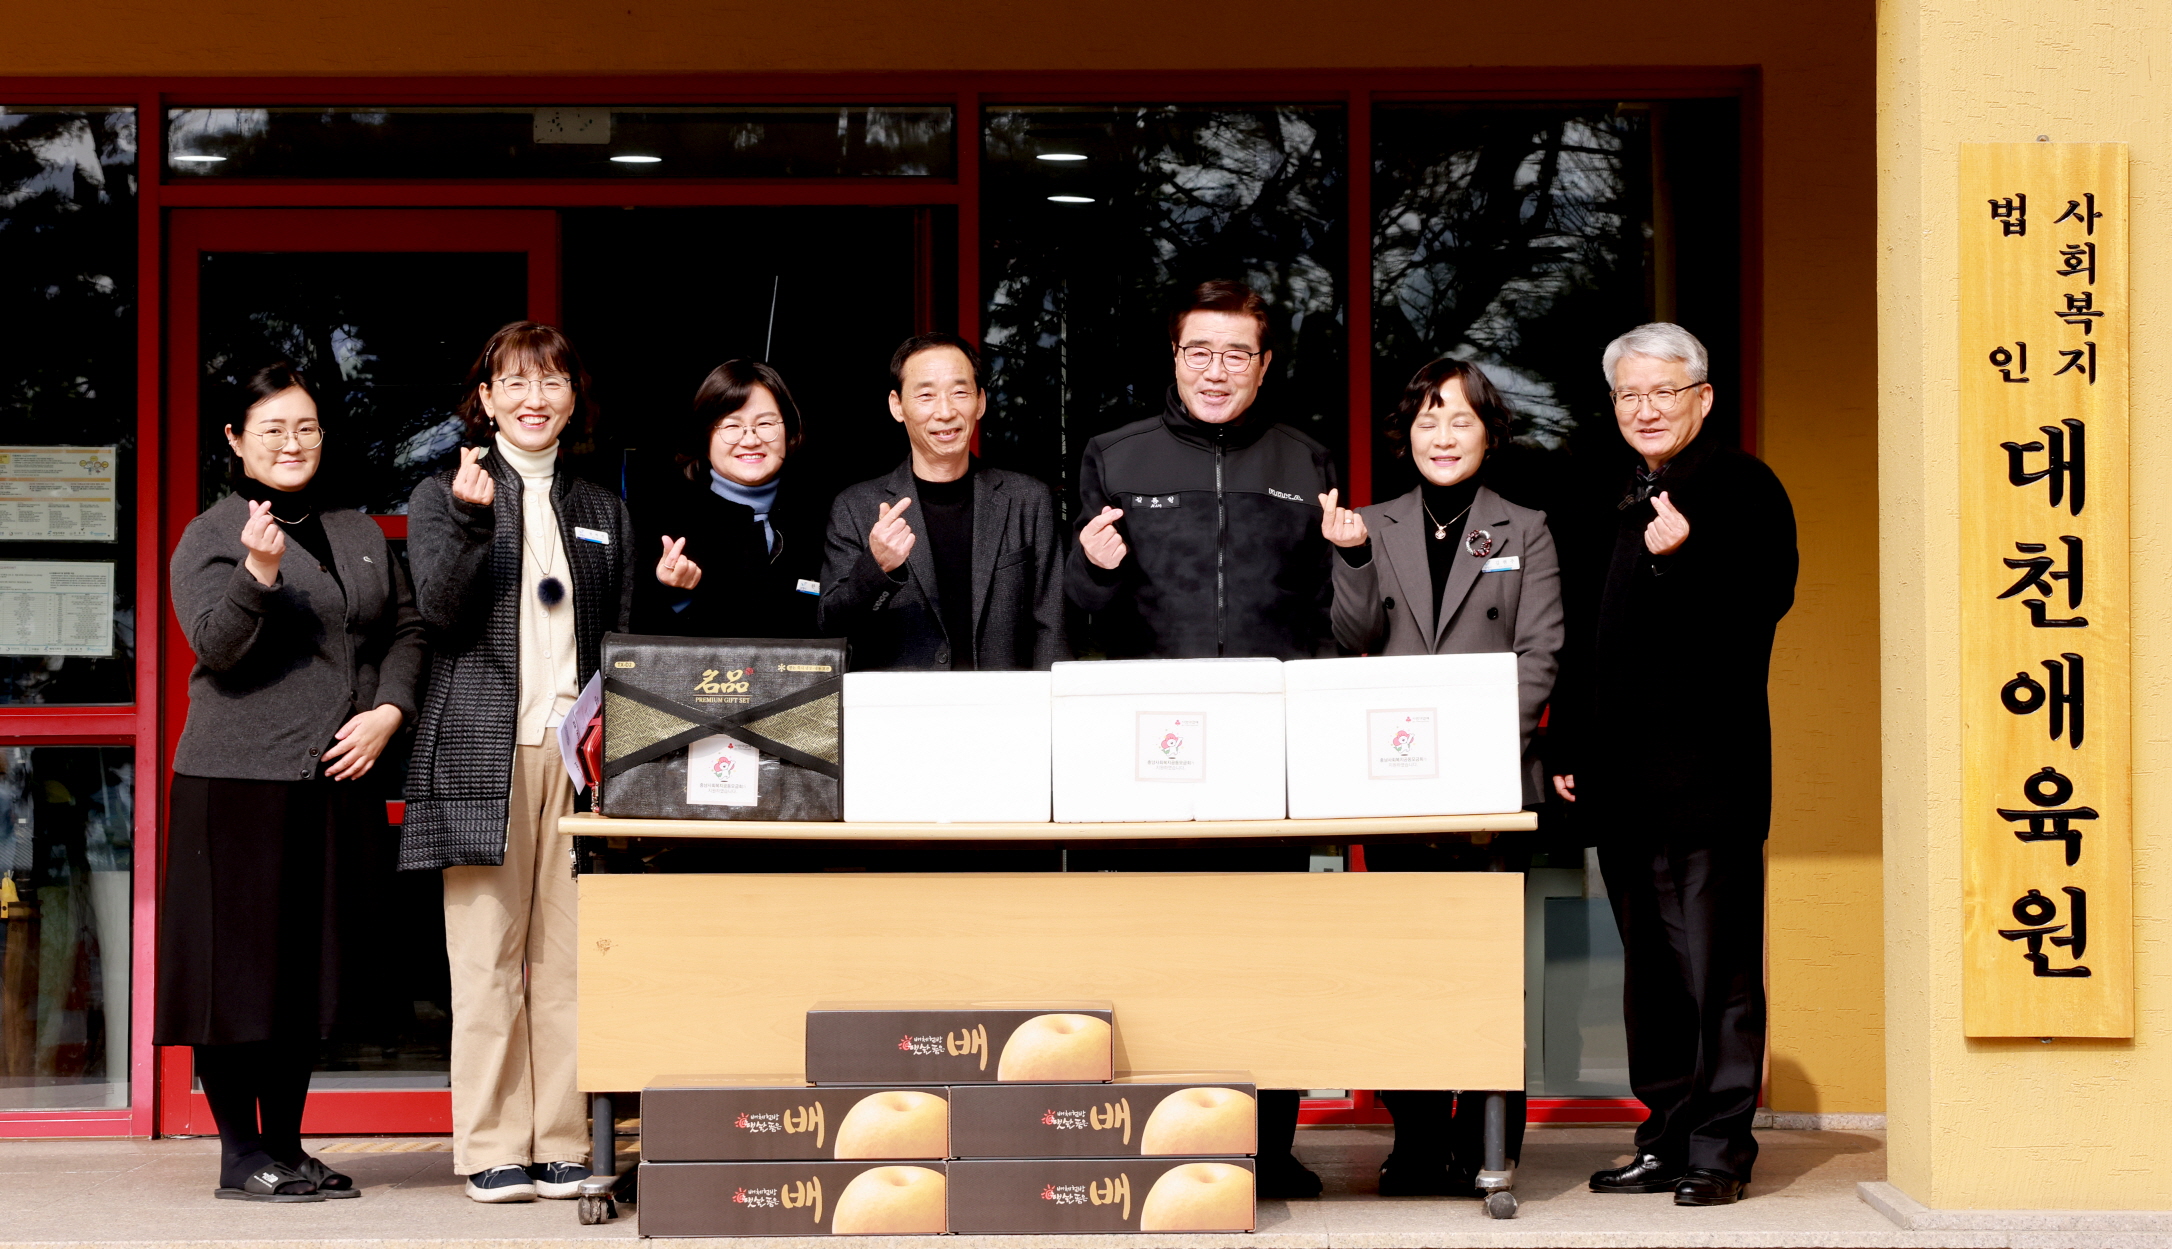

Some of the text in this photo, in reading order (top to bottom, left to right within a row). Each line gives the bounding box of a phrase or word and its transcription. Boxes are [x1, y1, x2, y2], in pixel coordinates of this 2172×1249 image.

[2053, 192, 2105, 386] 사회복지
[694, 669, 749, 693] 名品
[1996, 418, 2100, 979] 대천애육원
[946, 1023, 988, 1071] 배
[783, 1101, 825, 1149] 배
[1089, 1097, 1132, 1145] 배
[781, 1175, 823, 1224] 배
[1089, 1172, 1131, 1220] 배
